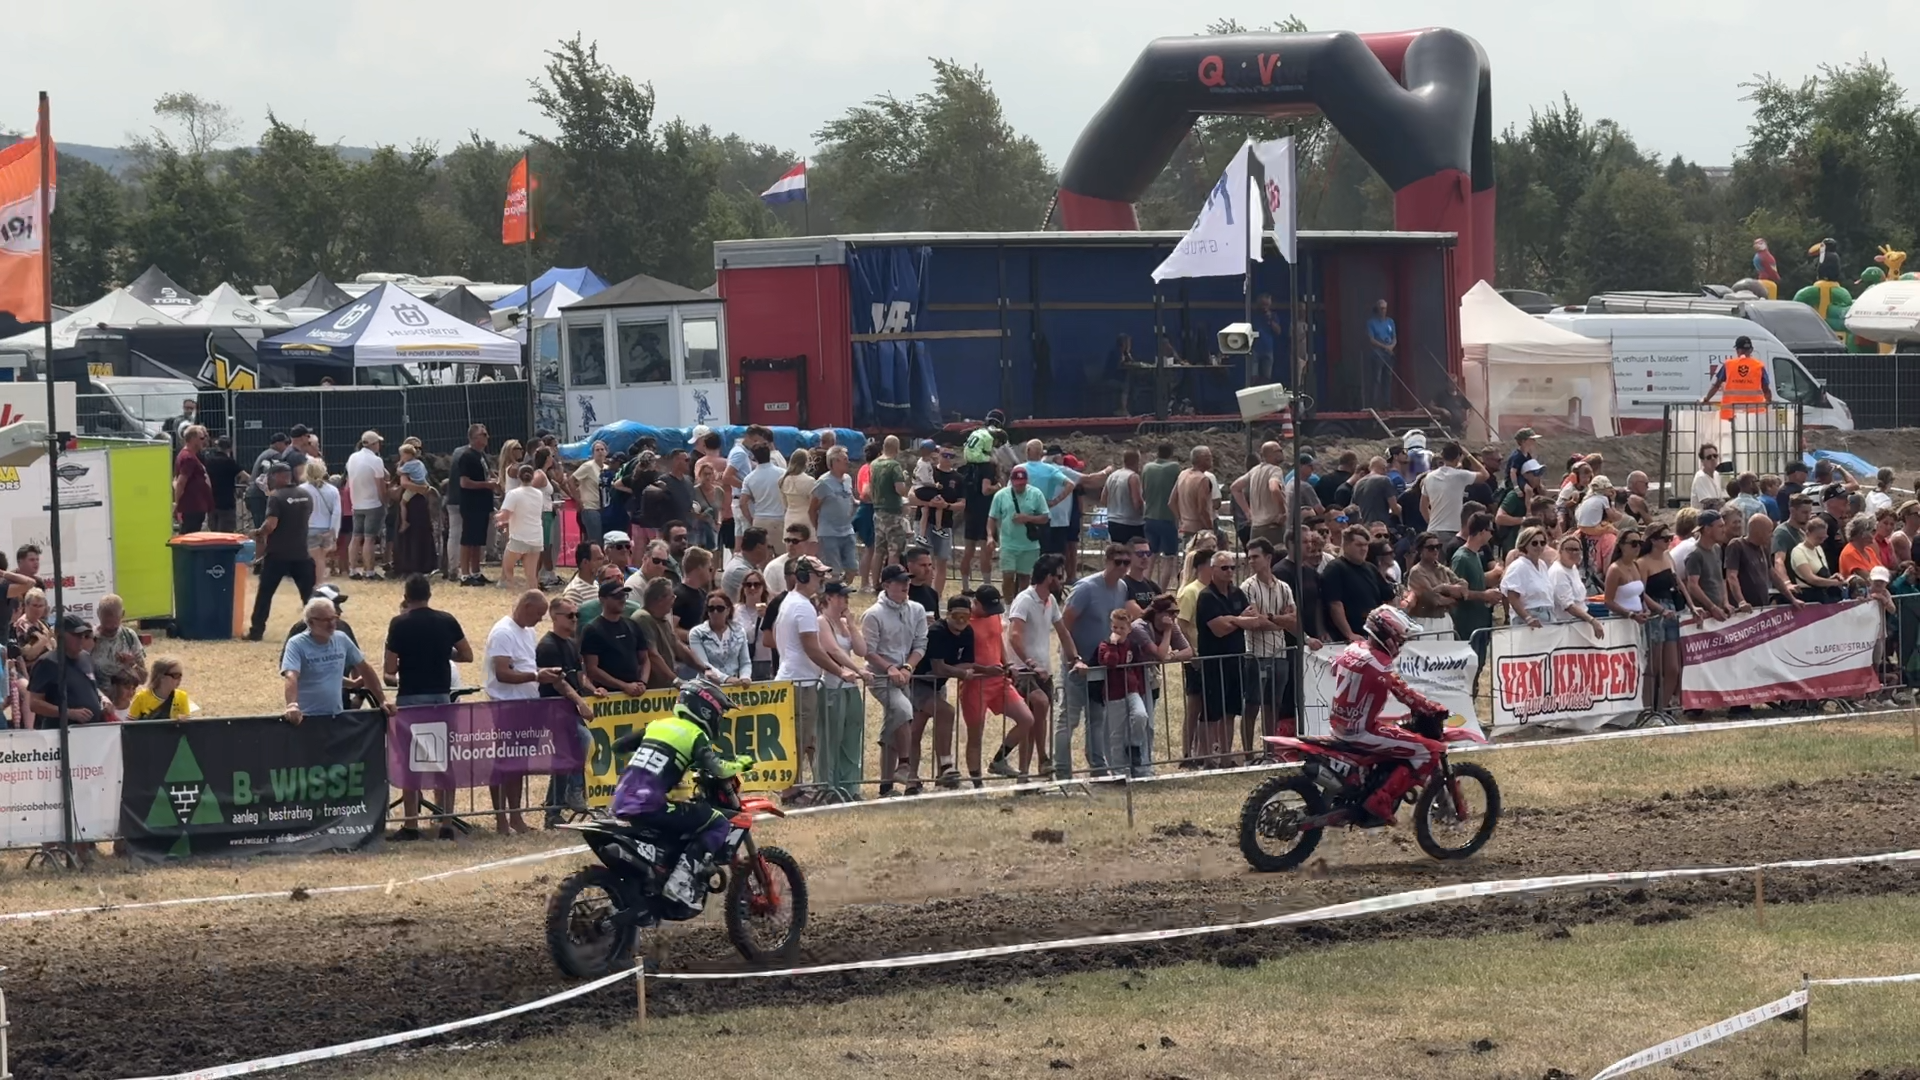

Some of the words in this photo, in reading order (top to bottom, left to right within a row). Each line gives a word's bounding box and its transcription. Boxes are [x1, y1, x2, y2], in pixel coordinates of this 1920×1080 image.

[387, 327, 460, 337] Husqvarna
[1502, 660, 1543, 704] VAN
[1552, 651, 1637, 697] KEMPEN
[450, 729, 512, 743] Strandcabine
[515, 726, 551, 739] verhuur
[450, 739, 556, 761] Noordduine.nl
[37, 766, 52, 783] bij
[55, 765, 104, 780] brijpen
[233, 771, 260, 805] B.
[270, 762, 365, 802] WISSE
[762, 769, 777, 782] 94
[780, 769, 793, 781] 39
[232, 809, 259, 825] aanleg
[268, 806, 314, 822] bestrating
[323, 801, 367, 817] transport
